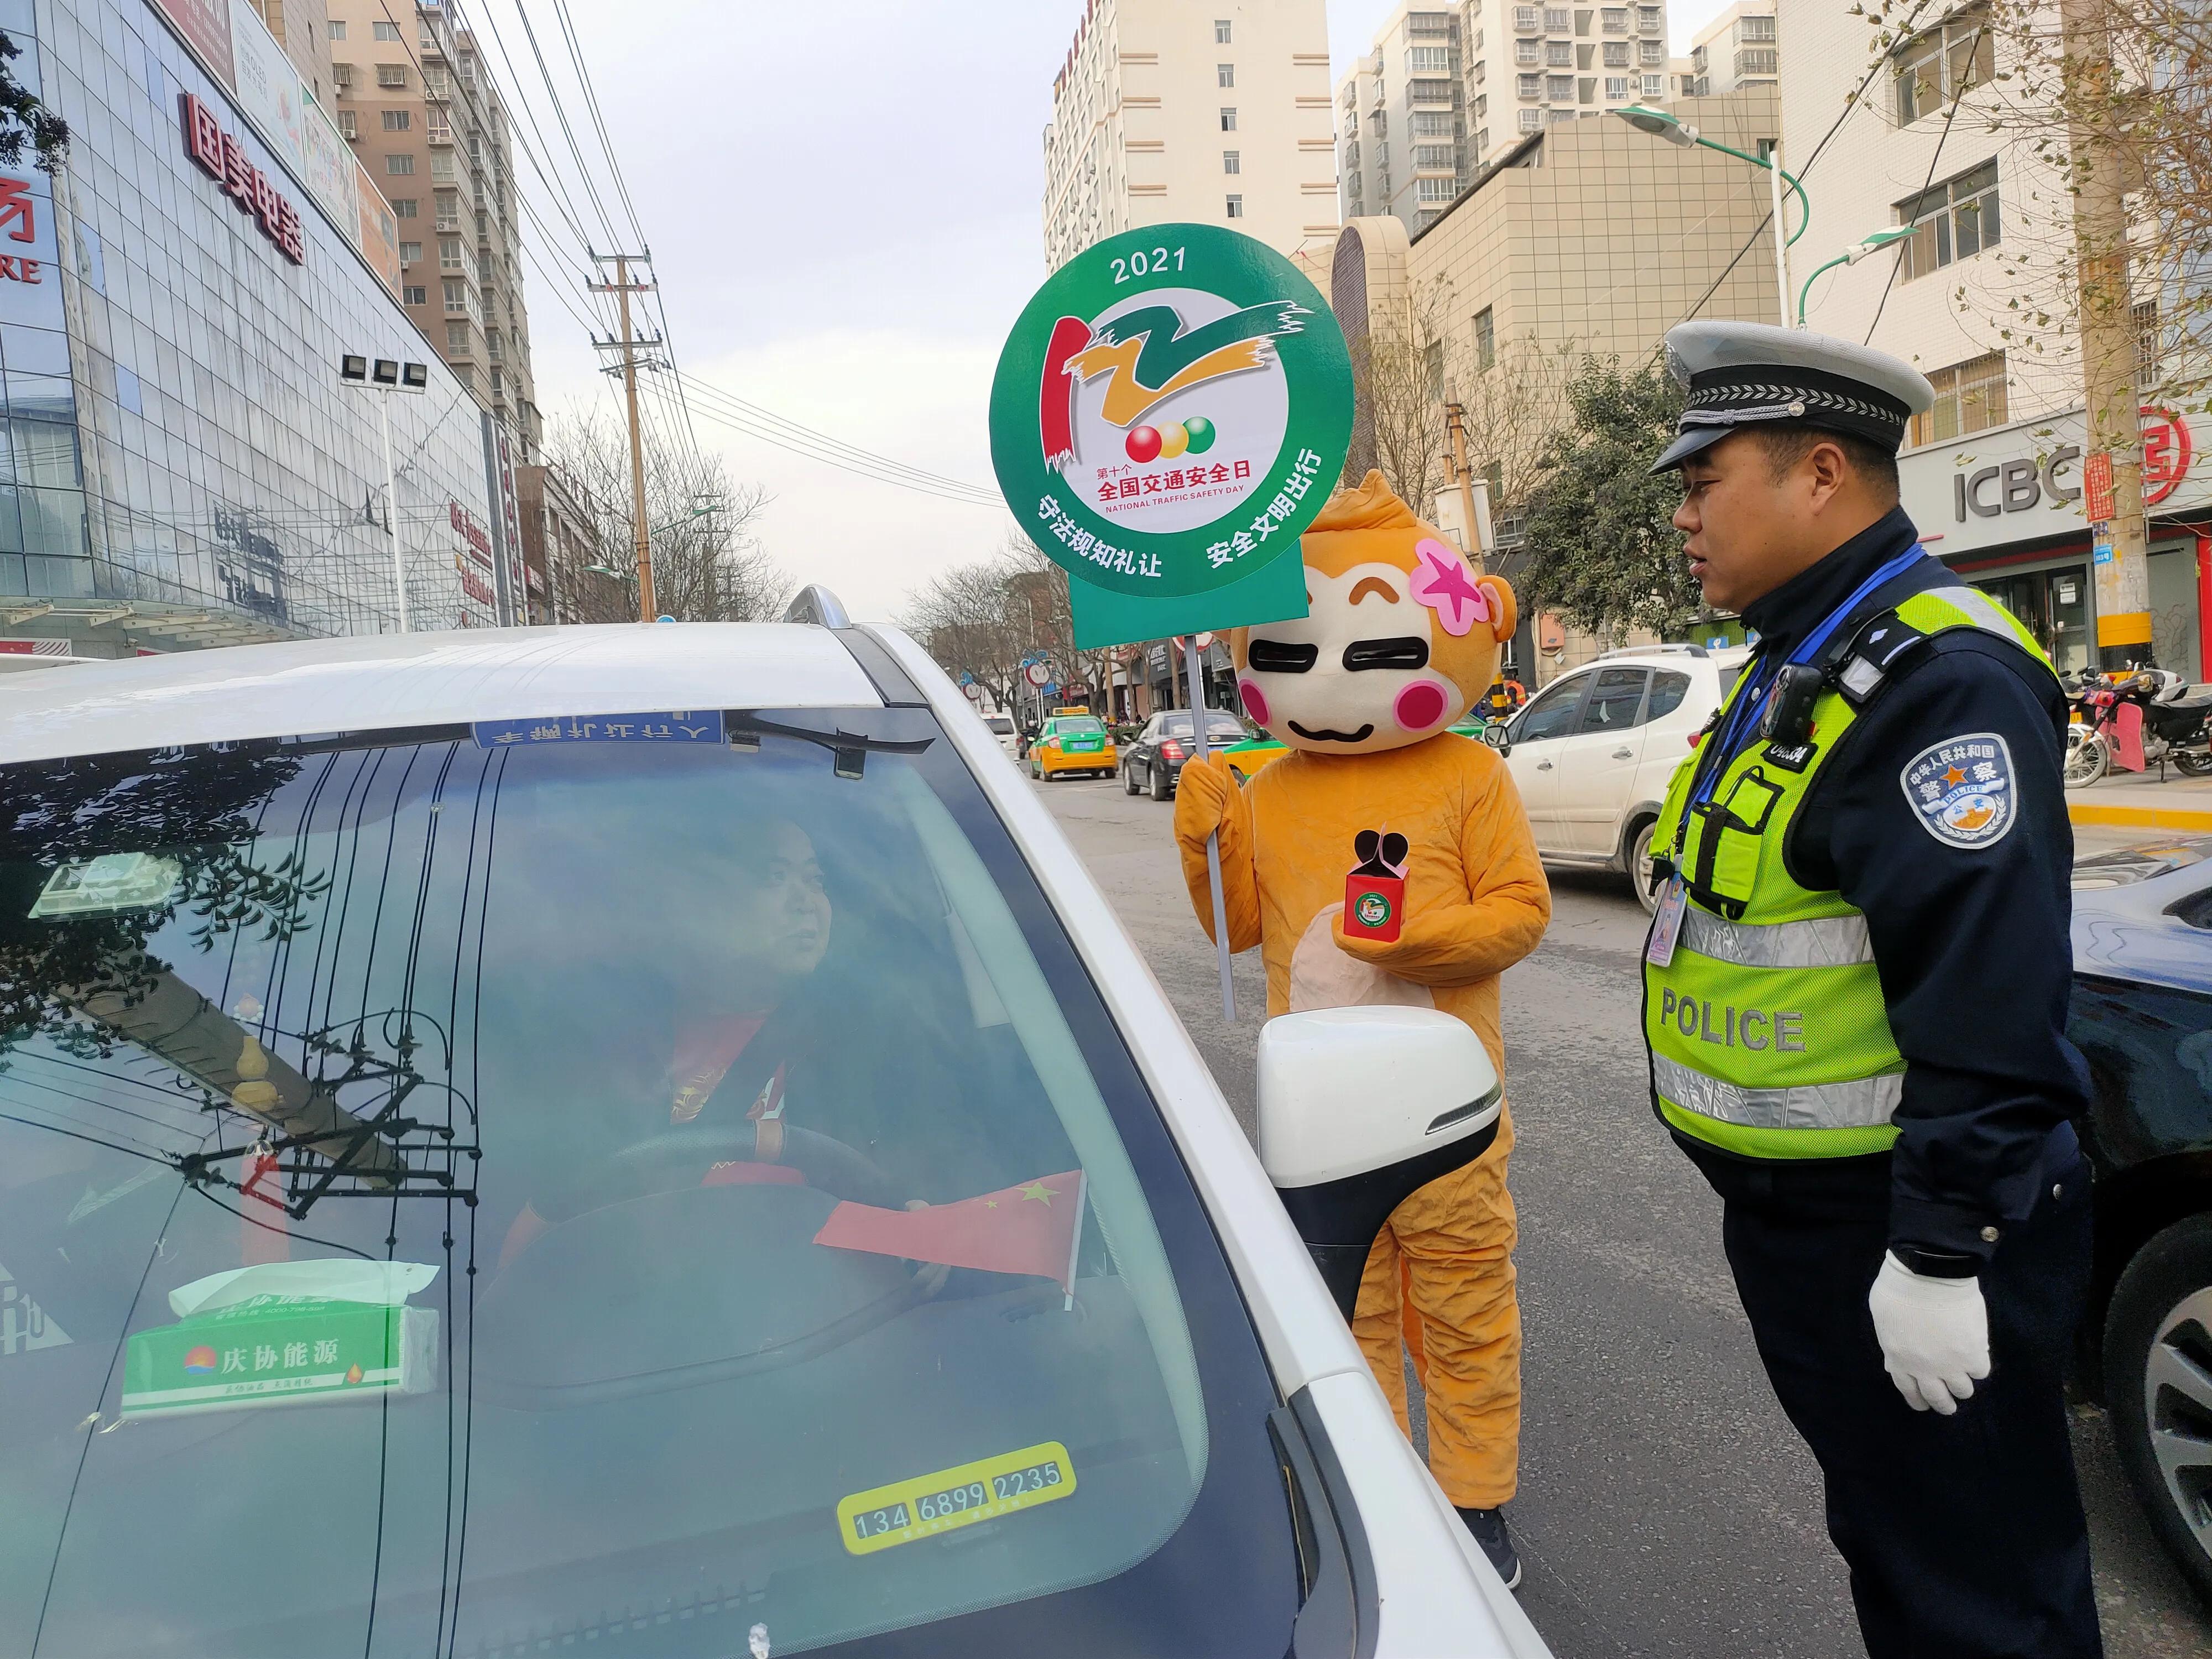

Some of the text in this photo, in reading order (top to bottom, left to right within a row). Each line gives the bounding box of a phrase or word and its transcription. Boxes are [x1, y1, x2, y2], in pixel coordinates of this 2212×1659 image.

[184, 93, 306, 265] 国美电器
[1110, 247, 1186, 285] 2021
[1097, 463, 1133, 480] 第十个
[1097, 460, 1251, 502] 全国交通安全日
[1954, 446, 2081, 523] ICBC
[1105, 484, 1244, 513] NATIONAL TRAFFIC SAFETY DAY
[1205, 447, 1323, 570] 安全文明出行
[1038, 493, 1163, 579] 守法规知礼让
[1910, 744, 1995, 786] 中华人民共和国
[1918, 761, 1997, 802] 警察
[1943, 785, 1983, 805] POLICE
[1661, 987, 1807, 1051] POLICE
[221, 1338, 340, 1375] 庆协能源
[856, 1462, 1061, 1538] 134 6899 2235
